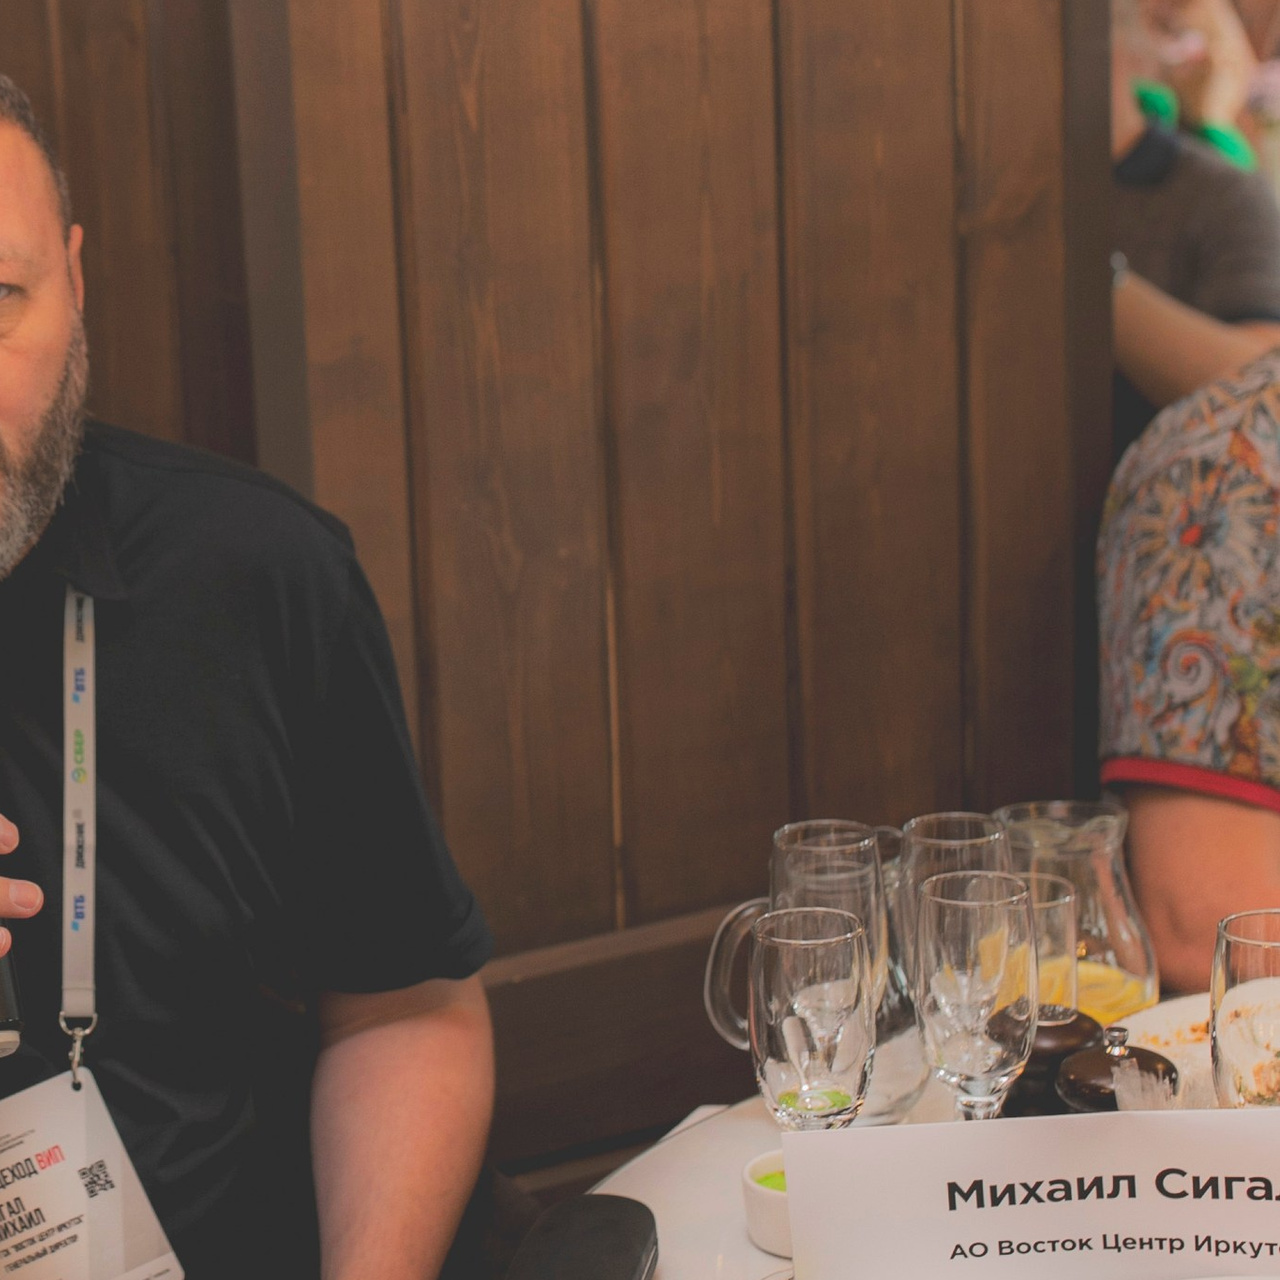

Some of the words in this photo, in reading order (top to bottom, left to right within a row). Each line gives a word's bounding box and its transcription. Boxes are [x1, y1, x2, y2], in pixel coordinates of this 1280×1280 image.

[74, 729, 85, 764] СБЕР
[74, 894, 86, 920] ВТБ
[35, 1145, 65, 1170] ВИП
[947, 1175, 1136, 1211] Михаил
[950, 1242, 989, 1260] АО
[998, 1237, 1093, 1256] Восток
[1102, 1234, 1185, 1254] Центр
[1194, 1235, 1280, 1259] Иркут
